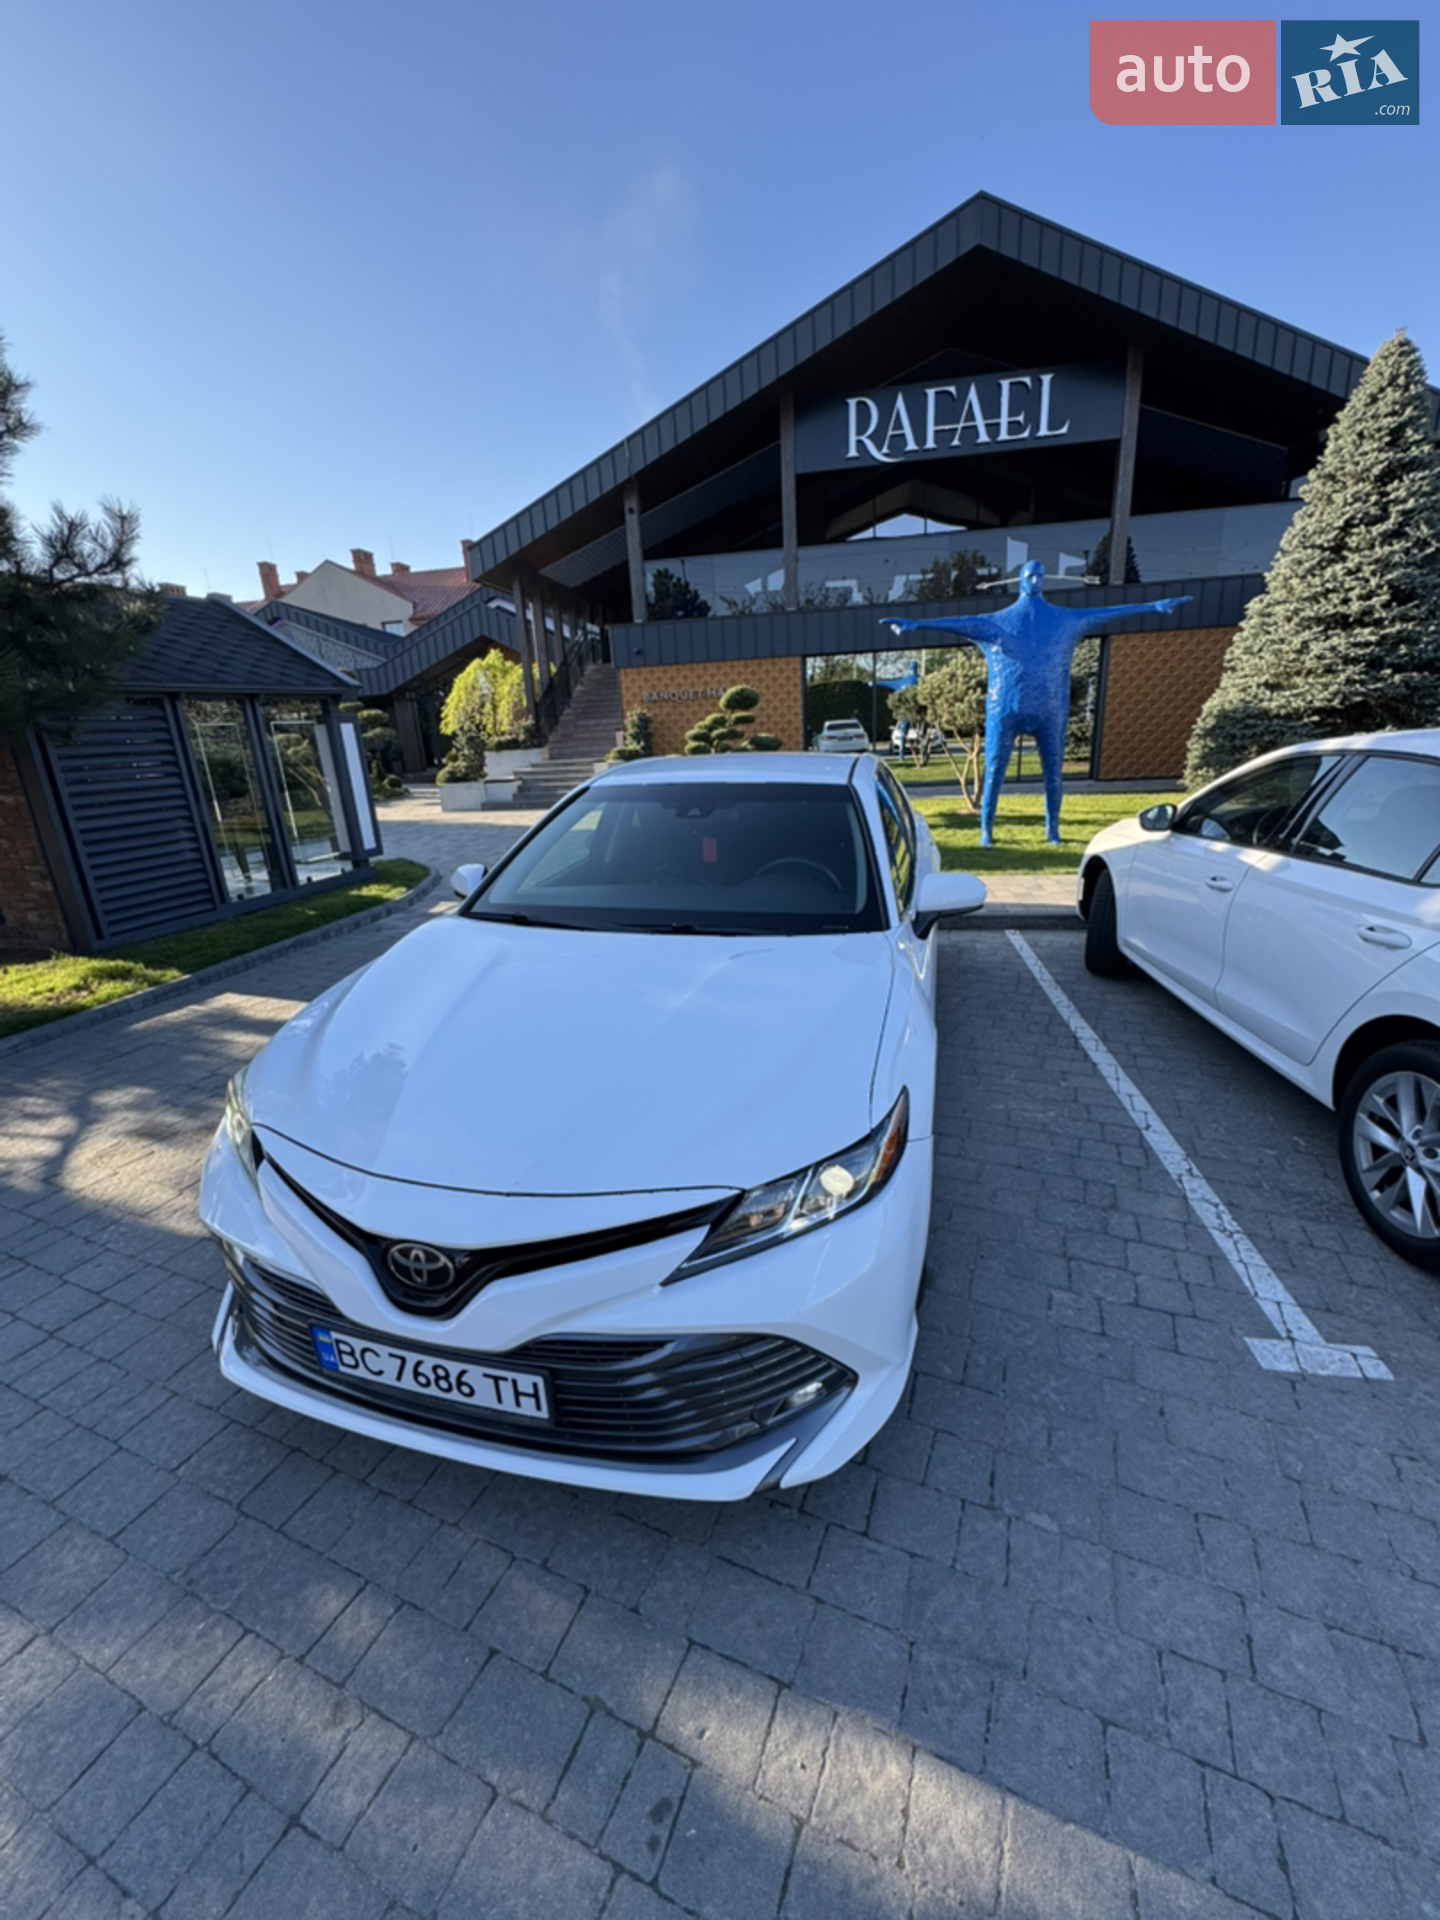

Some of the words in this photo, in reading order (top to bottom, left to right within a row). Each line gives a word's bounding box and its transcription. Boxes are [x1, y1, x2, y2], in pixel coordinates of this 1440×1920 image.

[846, 373, 1070, 463] RAFAEL
[643, 689, 702, 703] BANQUET
[482, 1373, 542, 1411] TH
